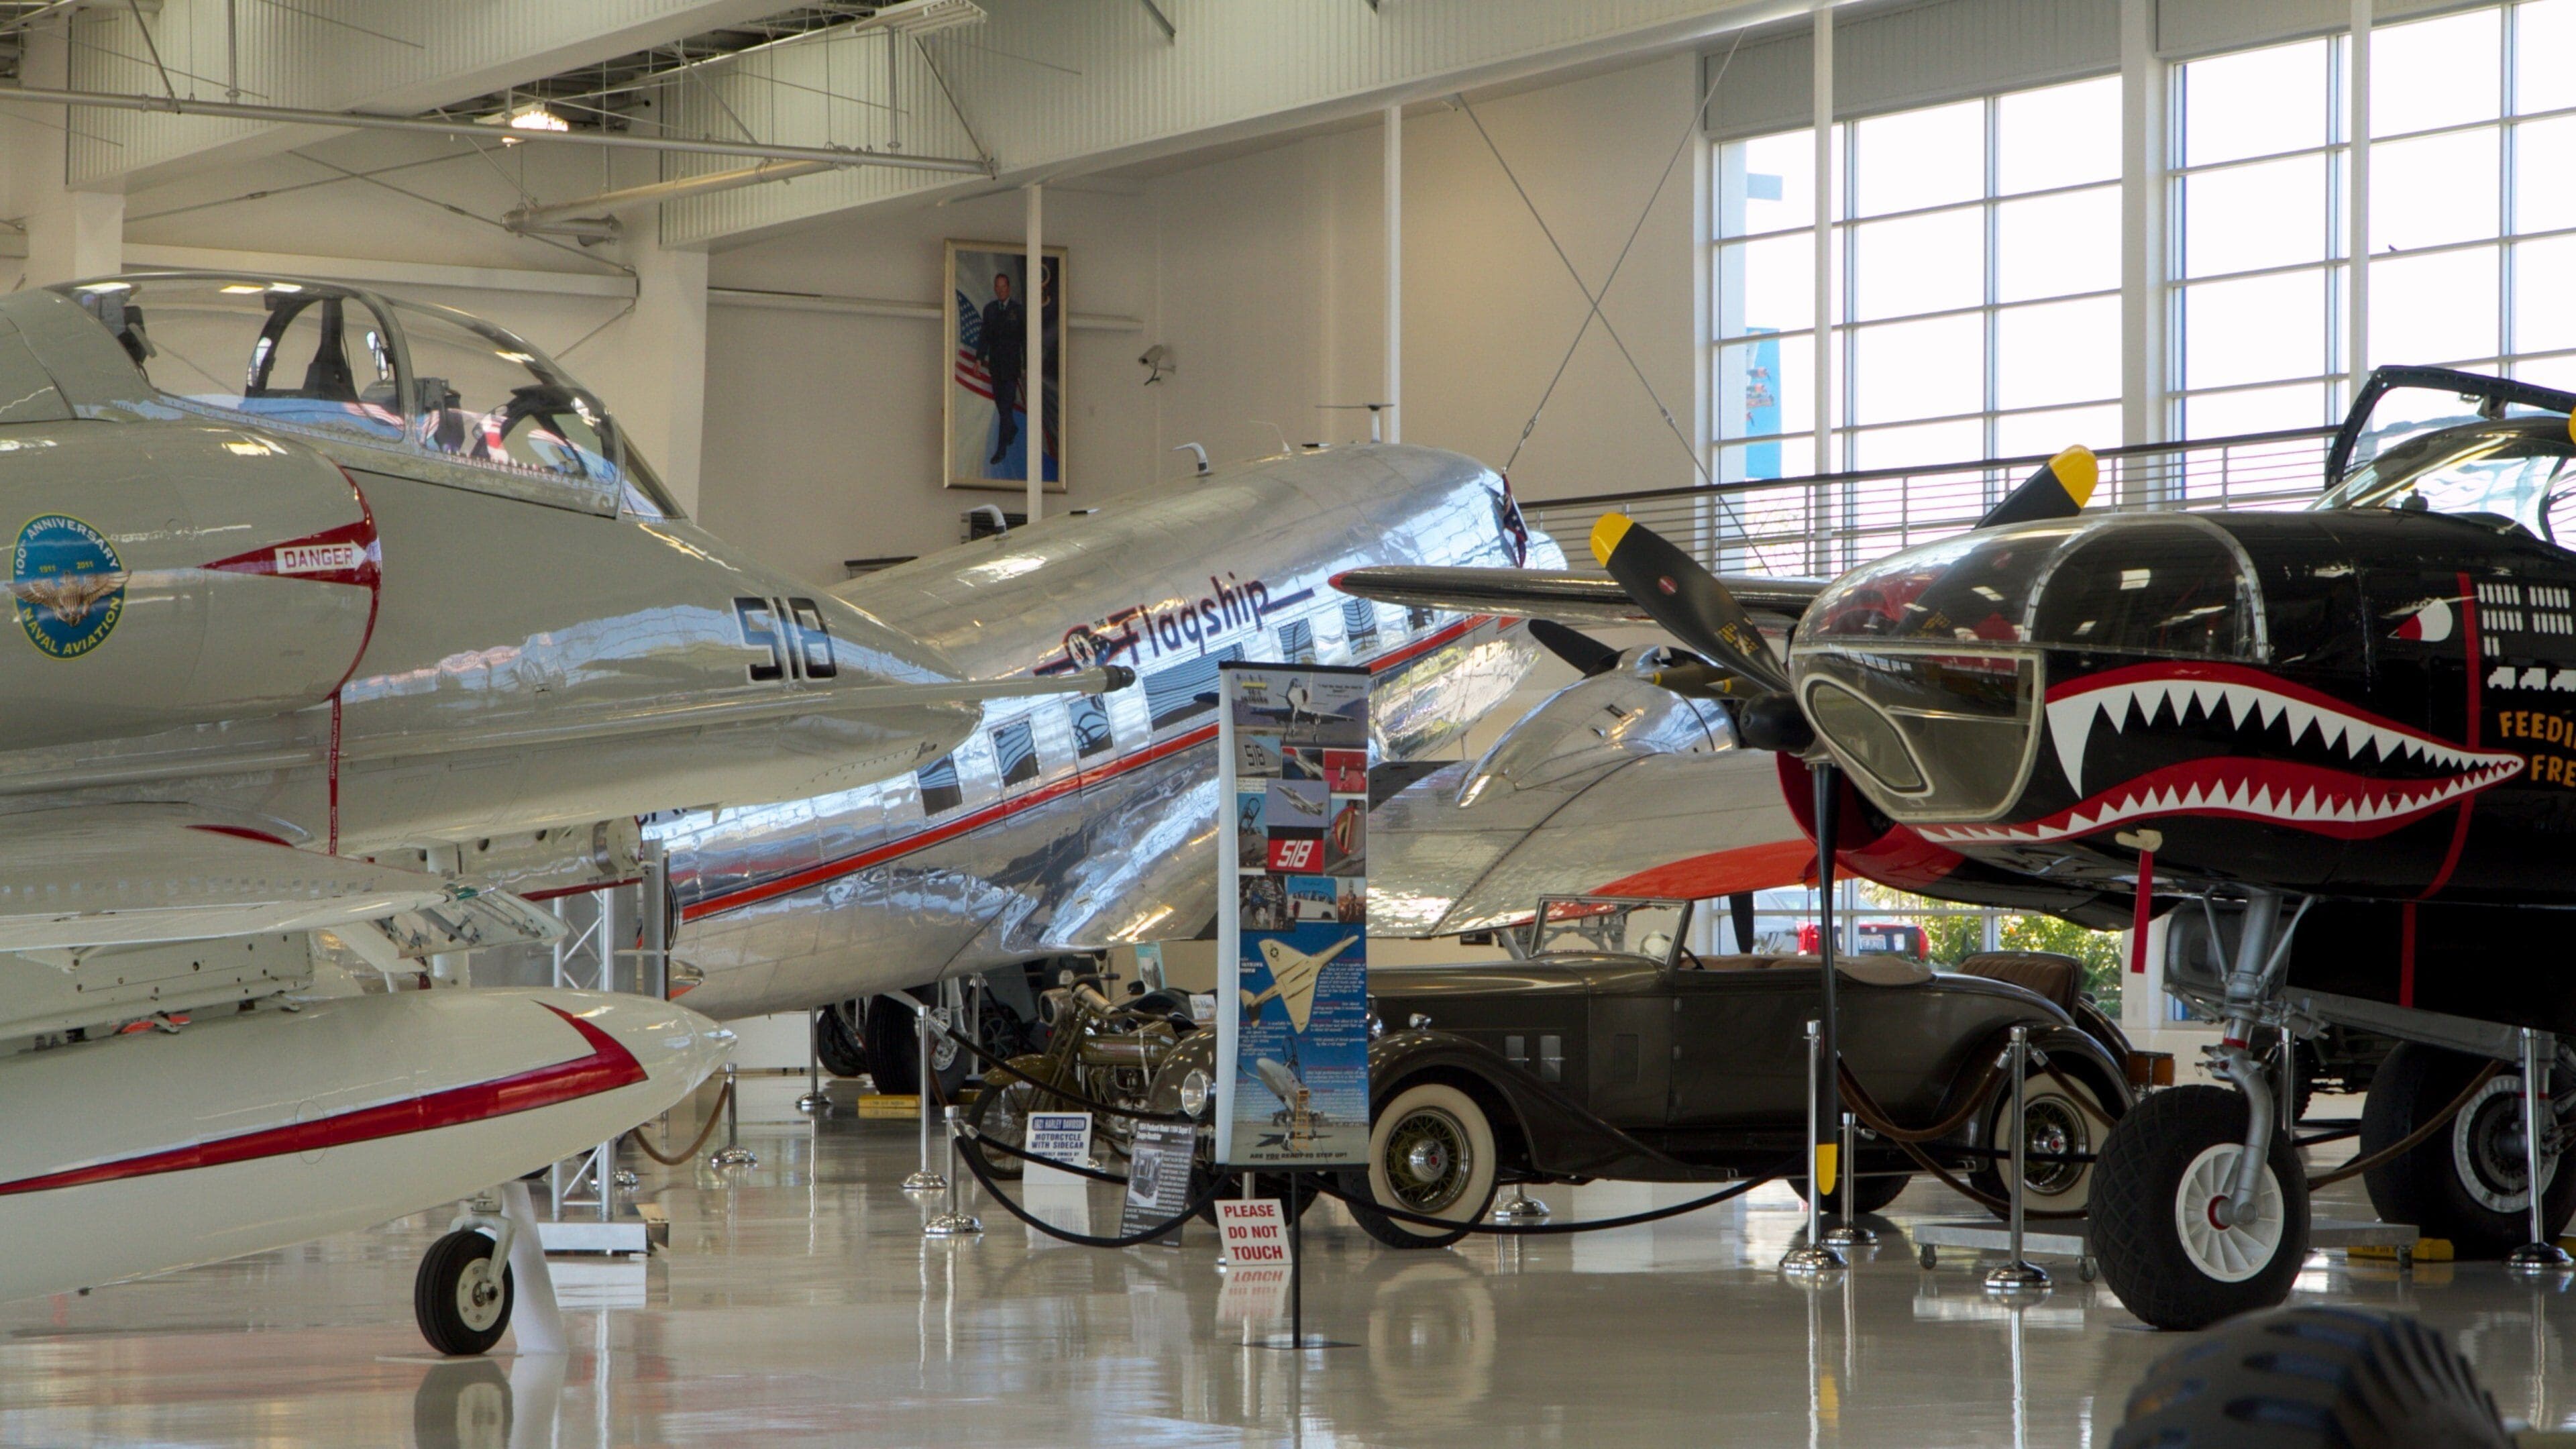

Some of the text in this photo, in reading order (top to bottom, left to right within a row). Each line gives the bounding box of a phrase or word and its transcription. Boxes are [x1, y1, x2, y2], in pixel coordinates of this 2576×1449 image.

[27, 518, 119, 568] ANNIVERSARY
[39, 560, 94, 573] 1911 2011
[283, 547, 354, 568] DANGER
[23, 596, 121, 655] NAVAL AVIATION
[1108, 571, 1269, 665] Flagship
[732, 597, 837, 682] 518
[2498, 710, 2576, 751] FEEDI
[1244, 744, 1266, 767] 518
[1276, 840, 1314, 868] 518
[1044, 1118, 1062, 1130] HARLEY
[1063, 1118, 1085, 1130] DAVIDSON
[1031, 1141, 1050, 1149] WITH
[1034, 1133, 1081, 1141] MOTORCYCLE
[1224, 1204, 1275, 1218] PLEASE
[1228, 1225, 1278, 1239] DO NOT
[1231, 1245, 1283, 1260] TOUCH
